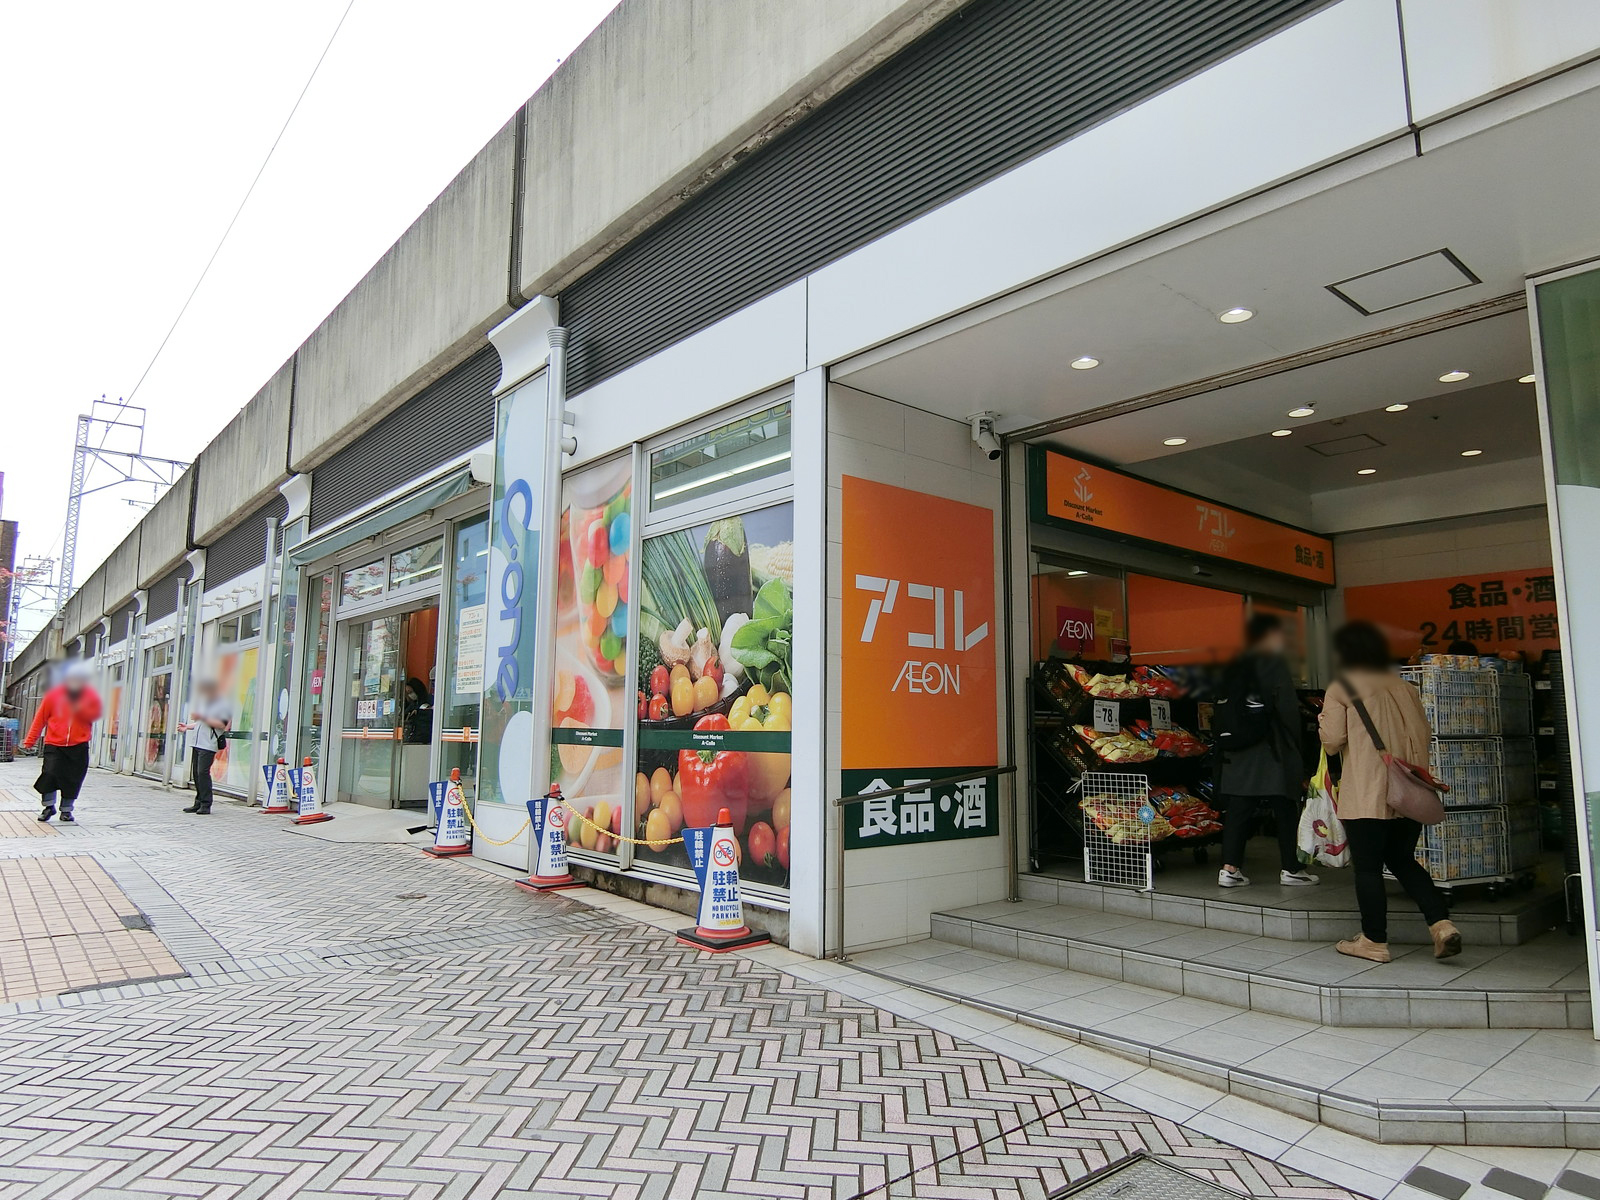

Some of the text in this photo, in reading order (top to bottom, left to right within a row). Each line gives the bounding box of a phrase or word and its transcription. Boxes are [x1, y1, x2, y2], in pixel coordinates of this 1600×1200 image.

[1063, 499, 1103, 516] Discount Market
[1196, 505, 1235, 538] アコレ
[1447, 575, 1556, 609] 食品・酒
[855, 574, 988, 651] アコレ
[1102, 707, 1113, 722] 78
[1157, 706, 1166, 720] 78
[858, 777, 987, 838] 食品・酒
[712, 870, 738, 886] 駐輪
[712, 887, 739, 902] 禁止
